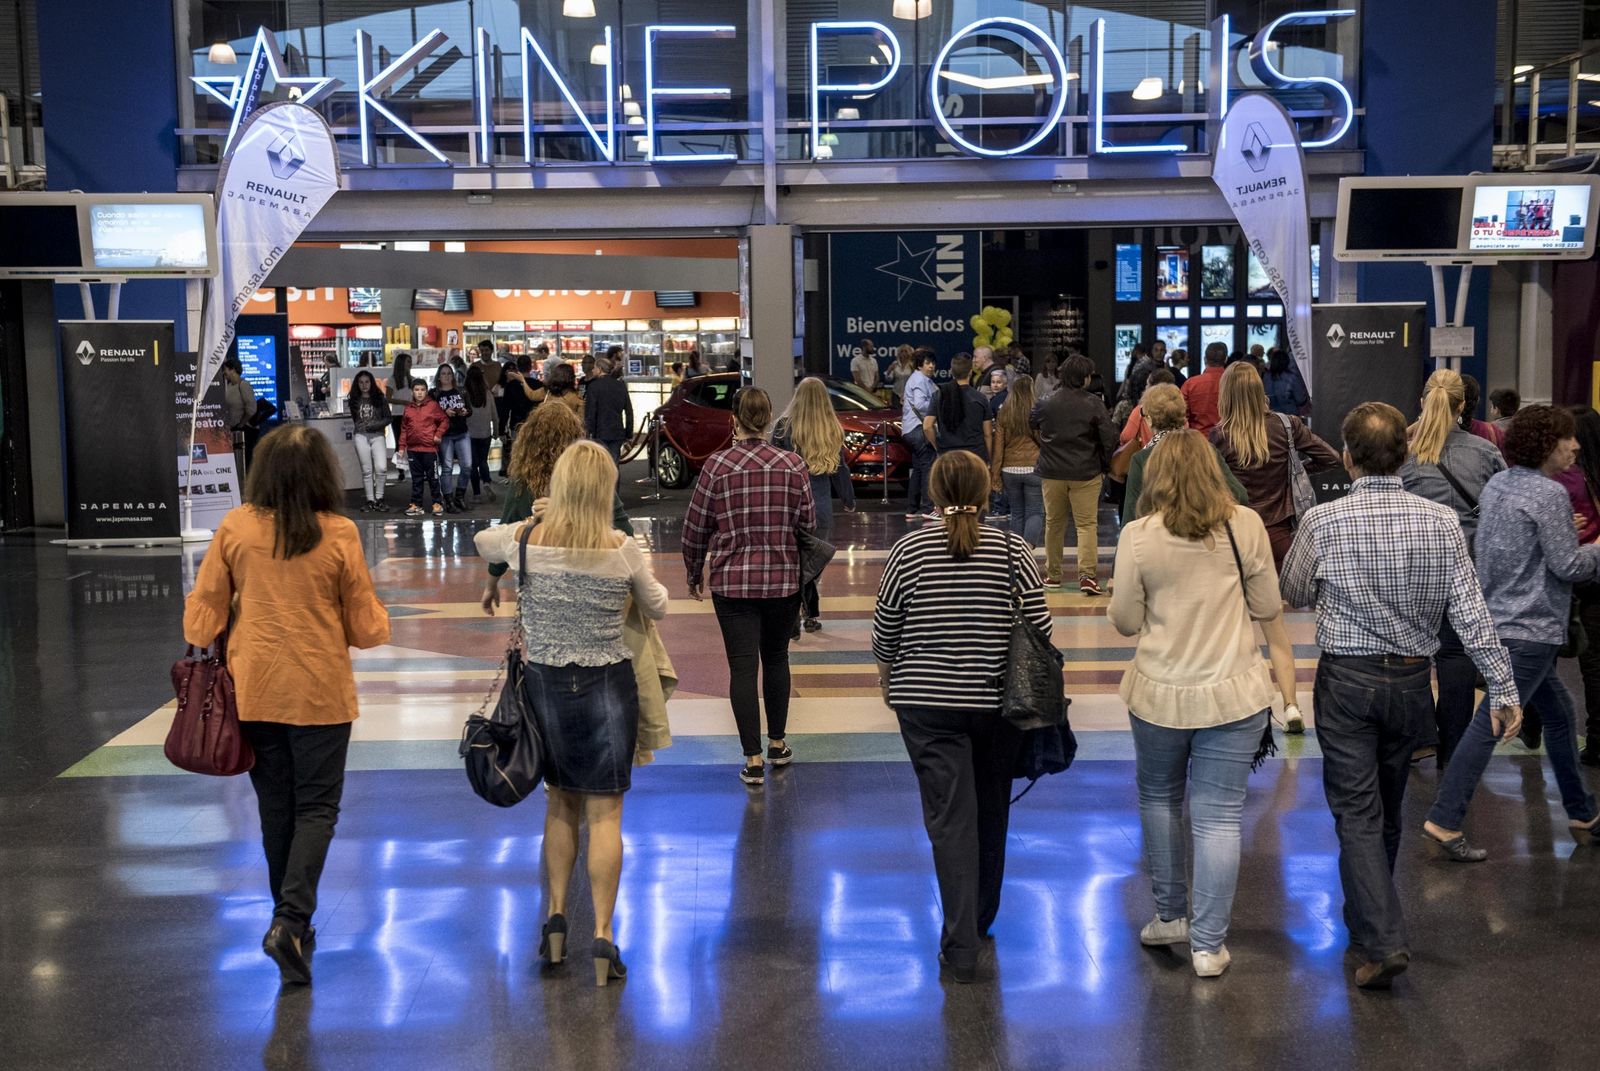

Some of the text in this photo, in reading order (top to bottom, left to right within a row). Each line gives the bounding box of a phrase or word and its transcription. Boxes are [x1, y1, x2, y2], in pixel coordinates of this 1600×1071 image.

[246, 181, 308, 205] RENAULT
[227, 190, 312, 218] JAPEMASA
[846, 316, 965, 333] Bienvenidos
[1350, 331, 1395, 339] RENAULT
[100, 349, 146, 357] RENAULT
[215, 466, 232, 474] CINE
